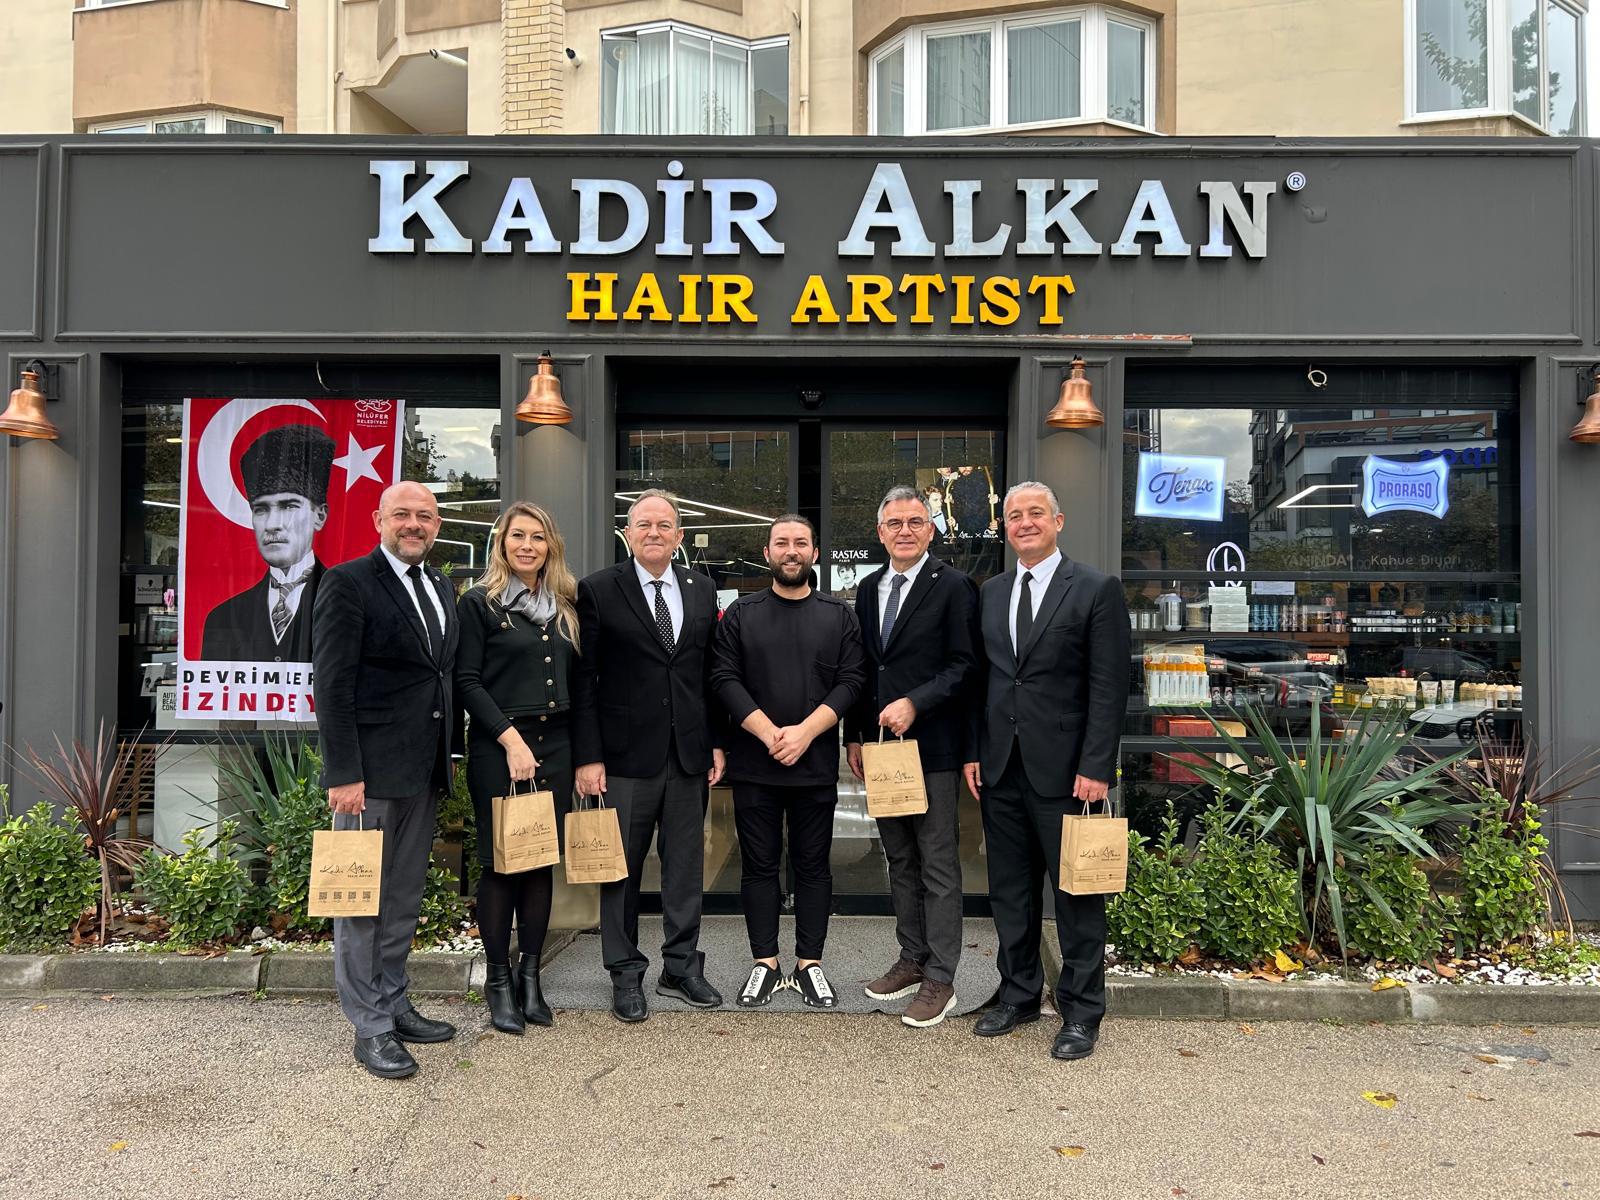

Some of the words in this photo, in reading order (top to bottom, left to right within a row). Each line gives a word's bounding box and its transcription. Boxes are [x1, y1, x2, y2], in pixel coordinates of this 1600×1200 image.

[368, 160, 785, 257] KADİR
[838, 162, 1277, 259] ALKAN
[566, 272, 759, 324] HAIR
[790, 273, 1076, 326] ARTIST
[356, 412, 389, 420] NİLÜFER
[1148, 467, 1214, 504] Tenax
[1379, 481, 1432, 499] PRORASO
